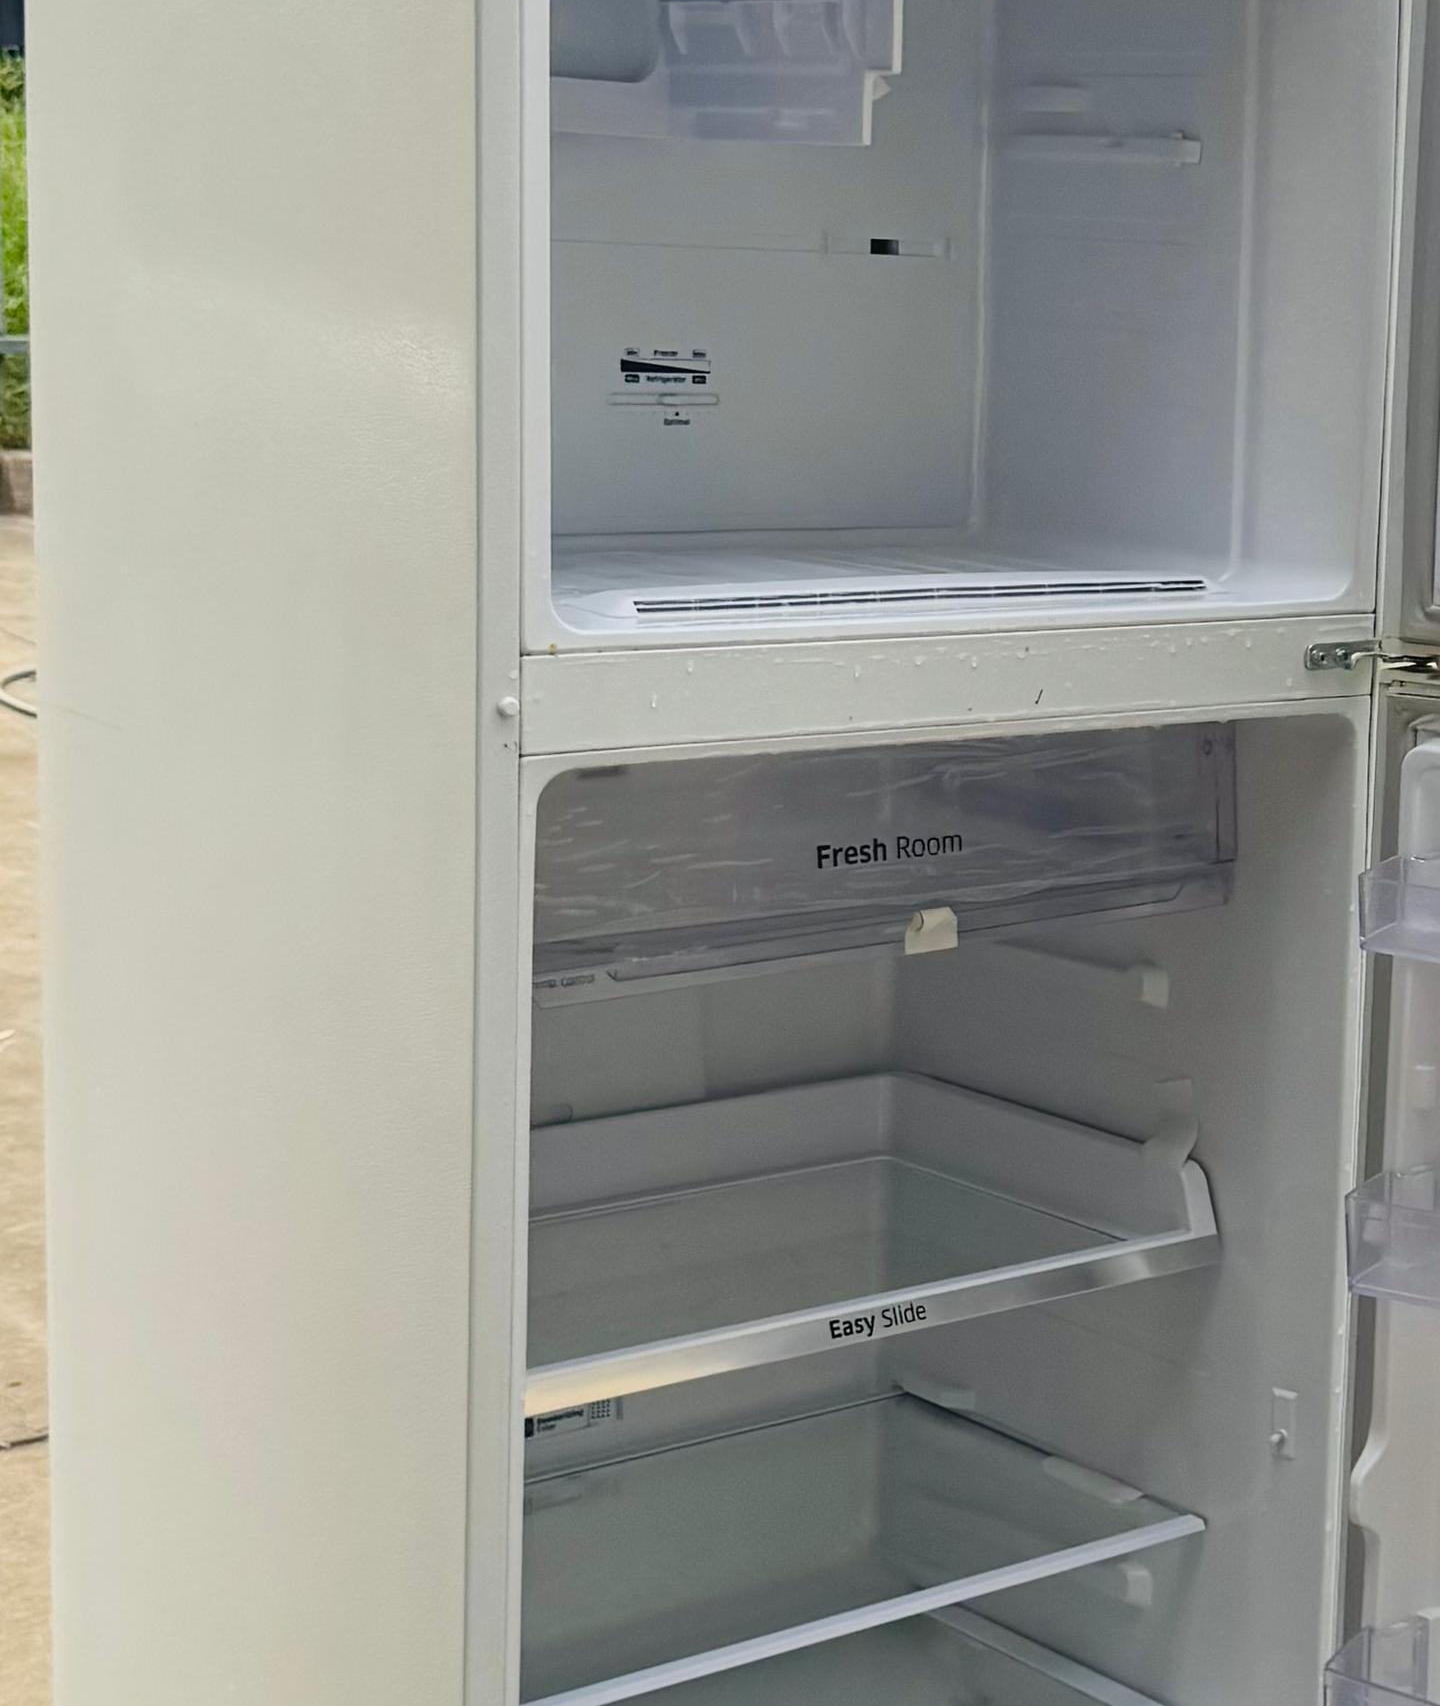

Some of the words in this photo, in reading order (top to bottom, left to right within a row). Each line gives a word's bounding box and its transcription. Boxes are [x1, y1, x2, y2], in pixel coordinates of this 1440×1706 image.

[816, 838, 887, 869] Fresh
[896, 834, 963, 859] Room
[829, 1315, 876, 1339] Easy
[881, 1302, 927, 1328] Slide
